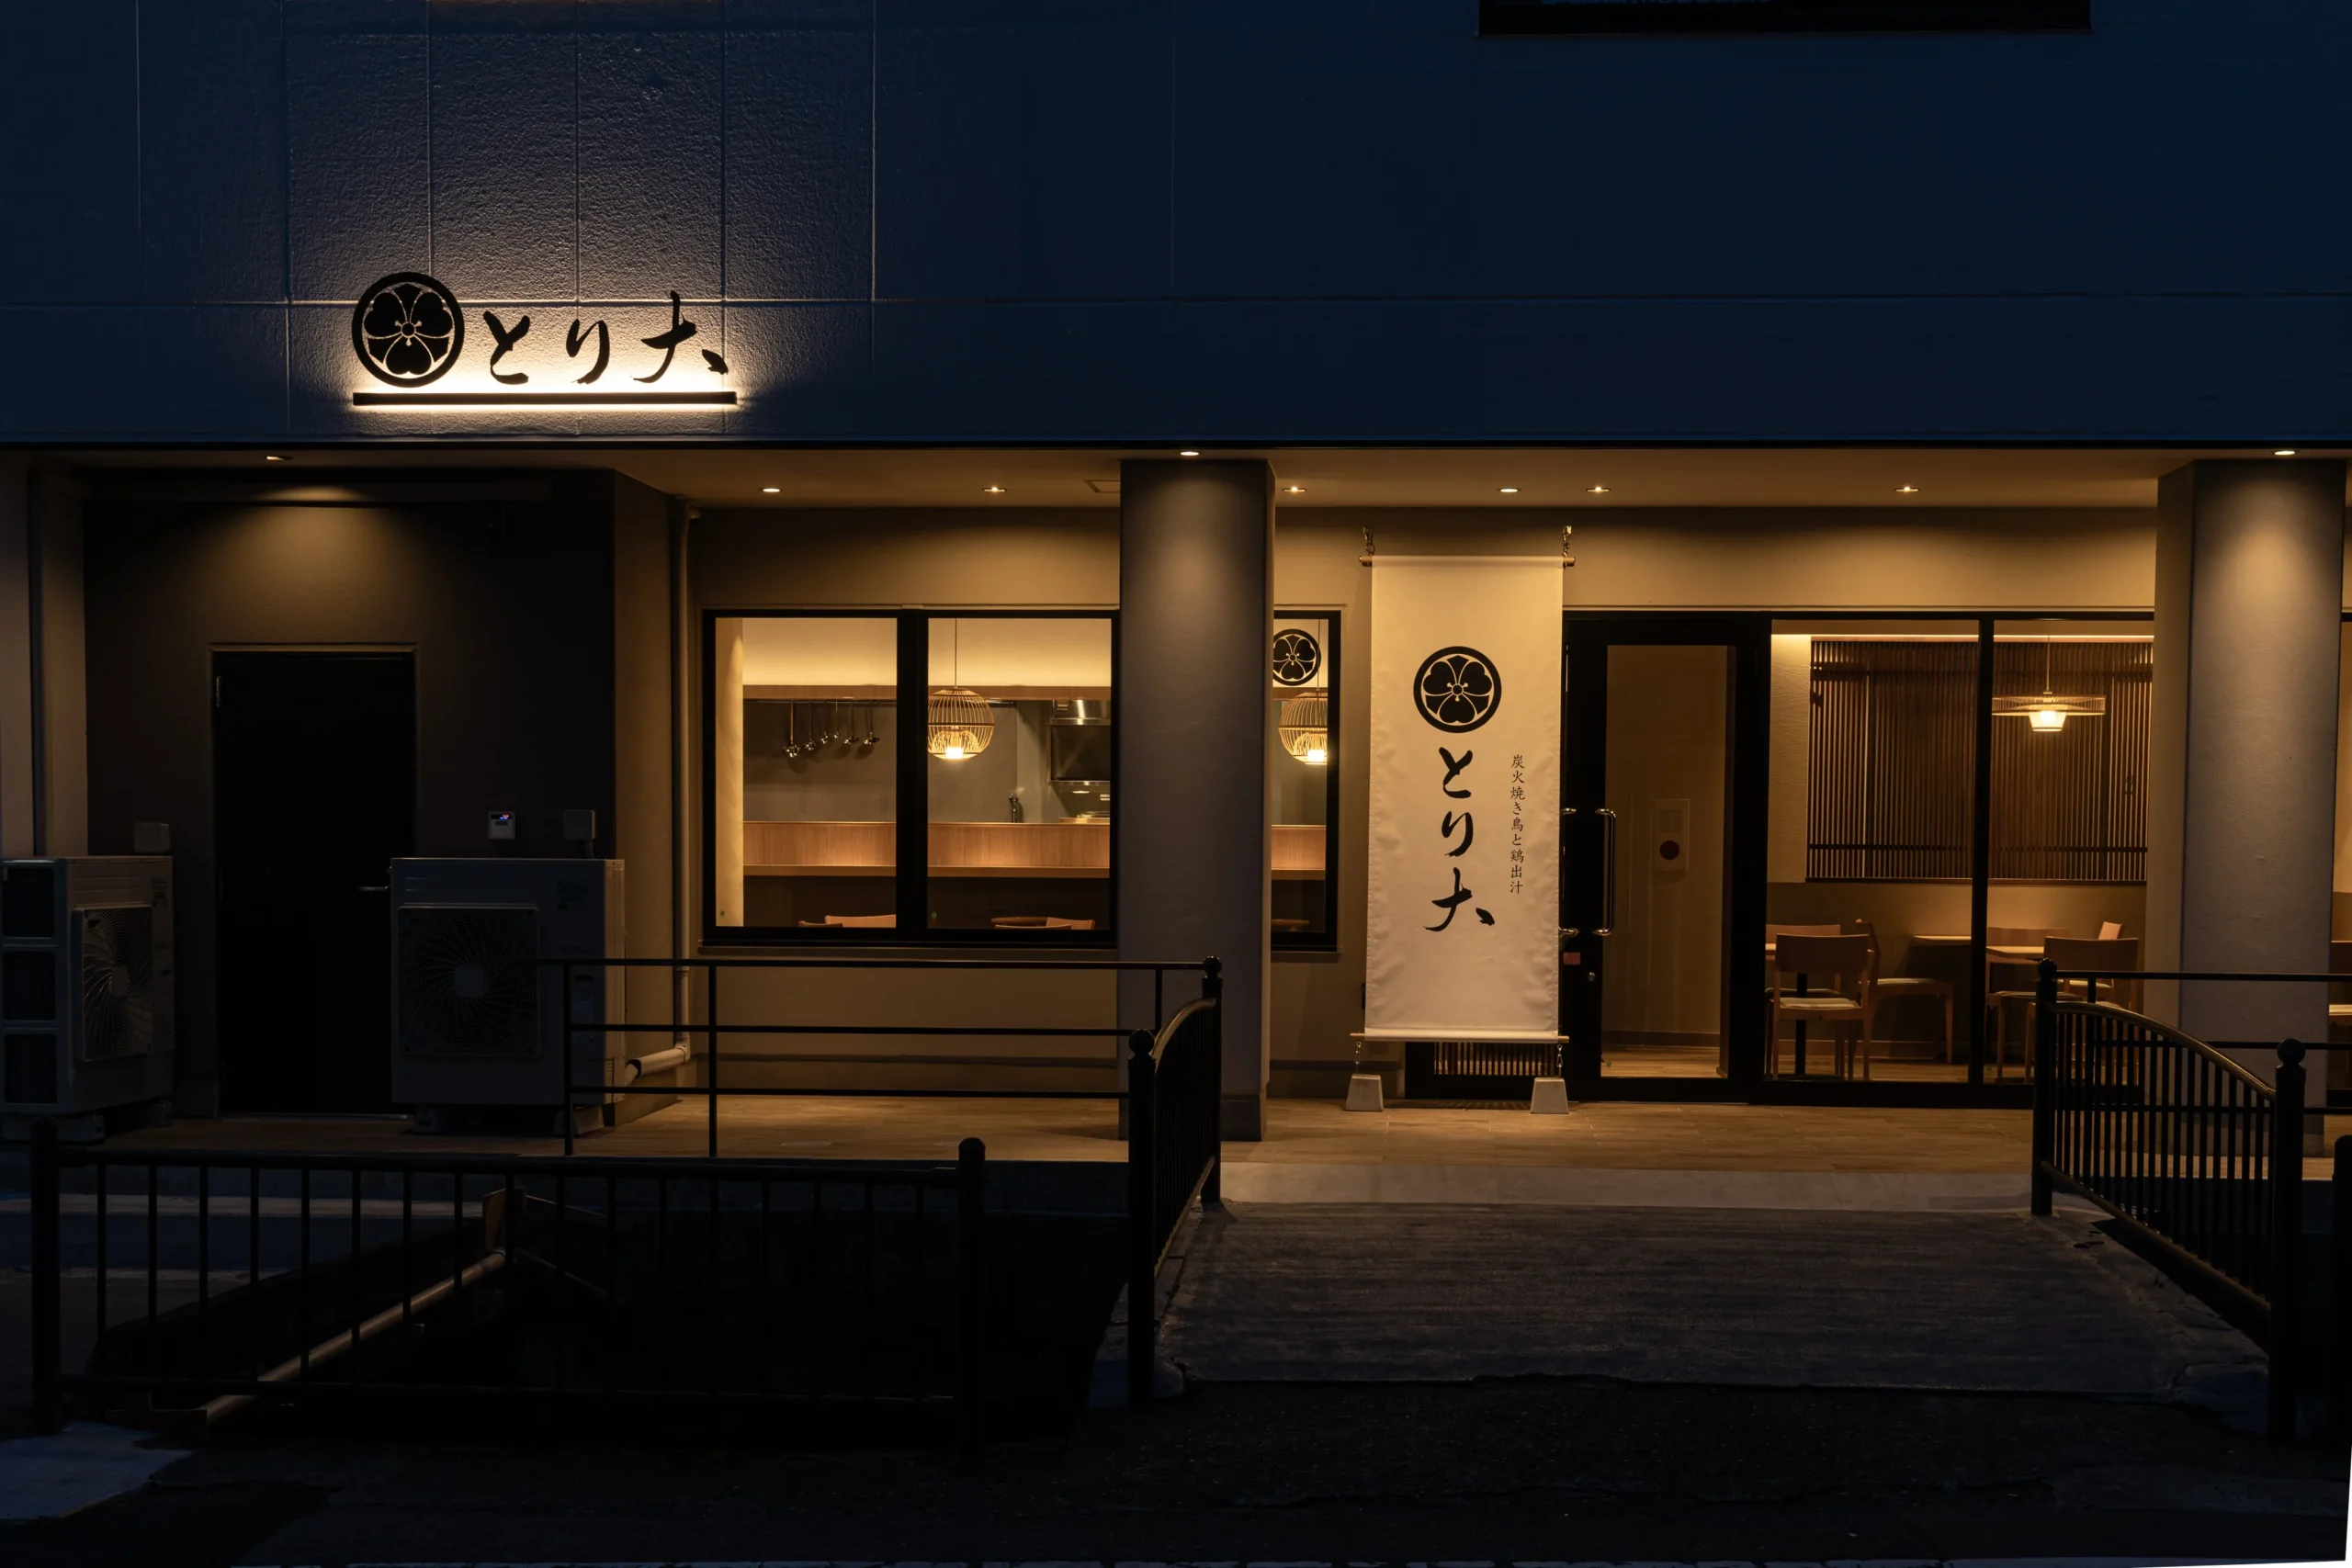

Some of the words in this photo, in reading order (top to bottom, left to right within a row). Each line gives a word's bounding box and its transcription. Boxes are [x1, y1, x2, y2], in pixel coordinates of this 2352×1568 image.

[1510, 754, 1525, 895] 炭火焼き鳥と鶏出汁
